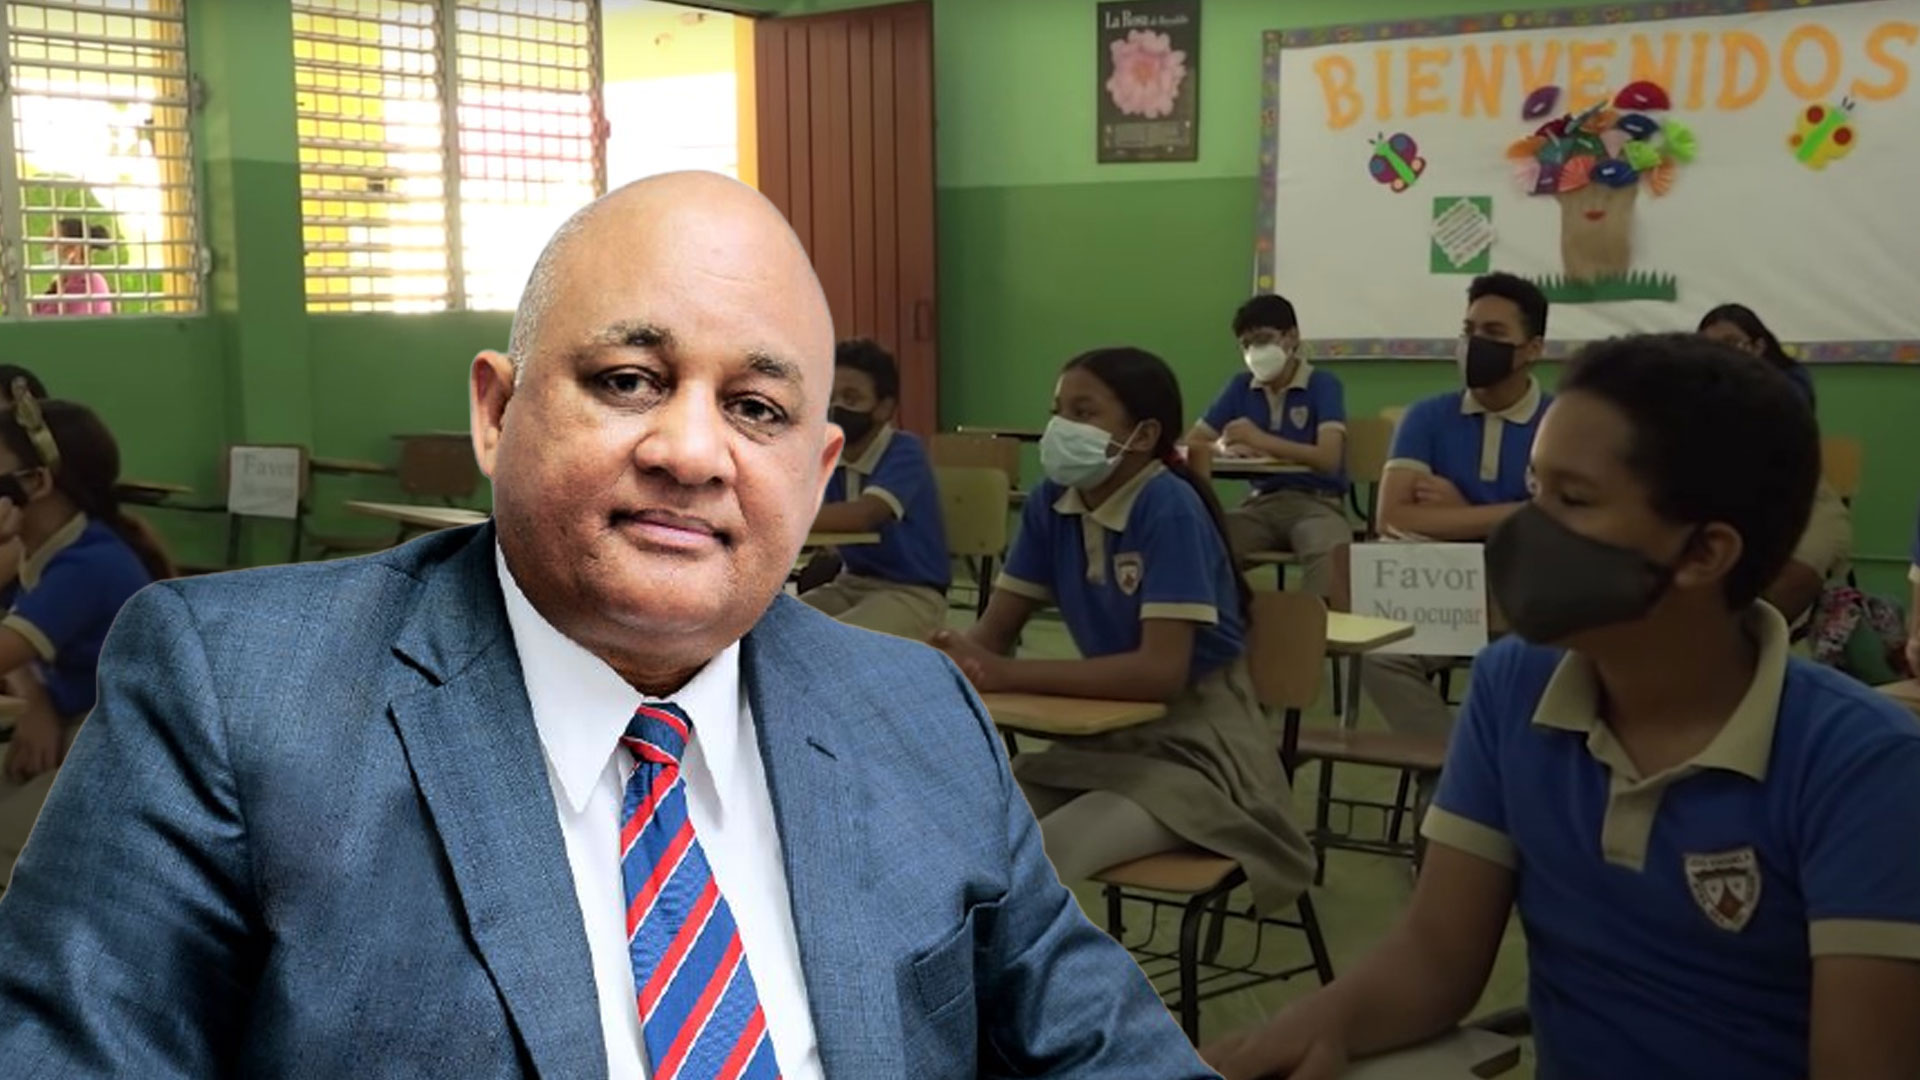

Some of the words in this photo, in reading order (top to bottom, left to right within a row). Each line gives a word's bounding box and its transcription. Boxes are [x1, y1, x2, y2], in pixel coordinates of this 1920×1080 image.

[1105, 11, 1120, 28] La
[1122, 9, 1148, 27] Rosa
[1313, 21, 1919, 131] BIENVENIDOS
[1373, 557, 1479, 591] Favor
[1373, 598, 1407, 621] No
[1413, 606, 1483, 631] ocupar
